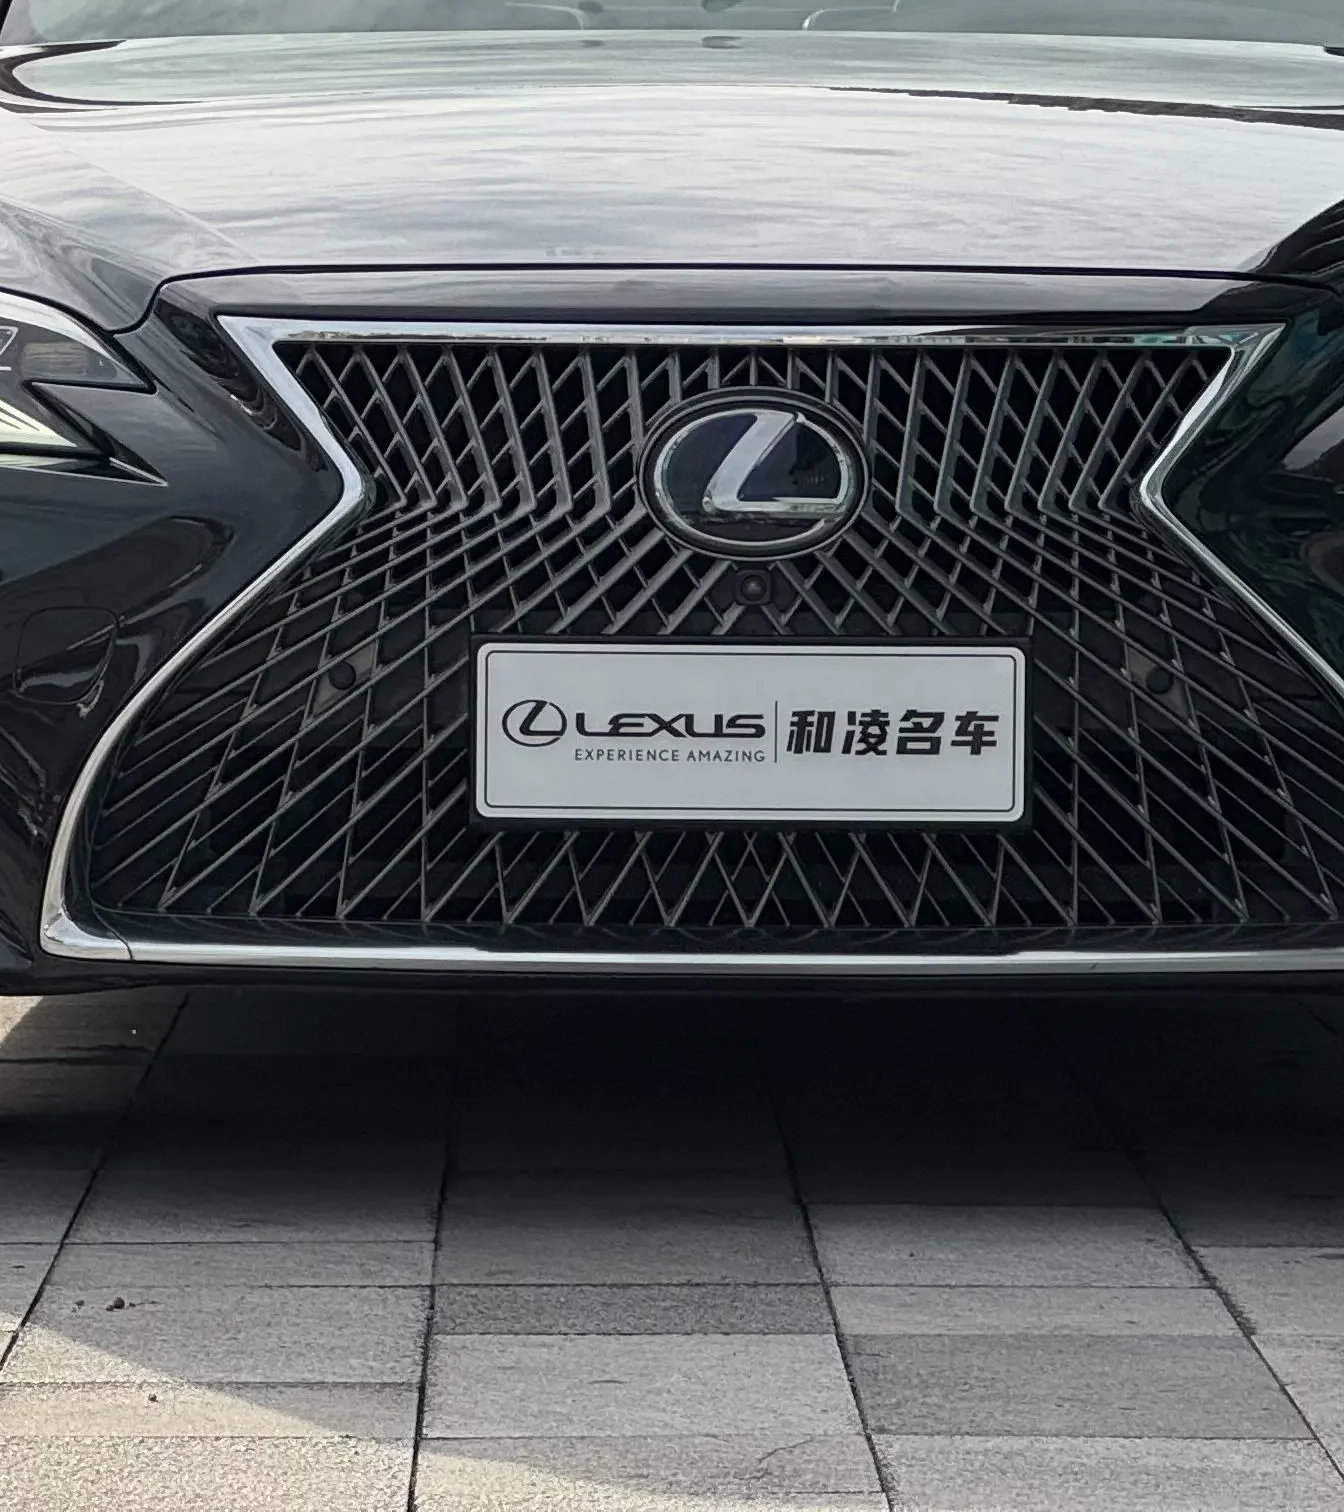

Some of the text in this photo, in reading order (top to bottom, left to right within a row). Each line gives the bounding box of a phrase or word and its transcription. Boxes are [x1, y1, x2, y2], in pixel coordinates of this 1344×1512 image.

[575, 712, 766, 739] LEXUS
[786, 708, 1000, 756] 和凌名车
[575, 748, 766, 763] EXPERIENCE AMAZING
